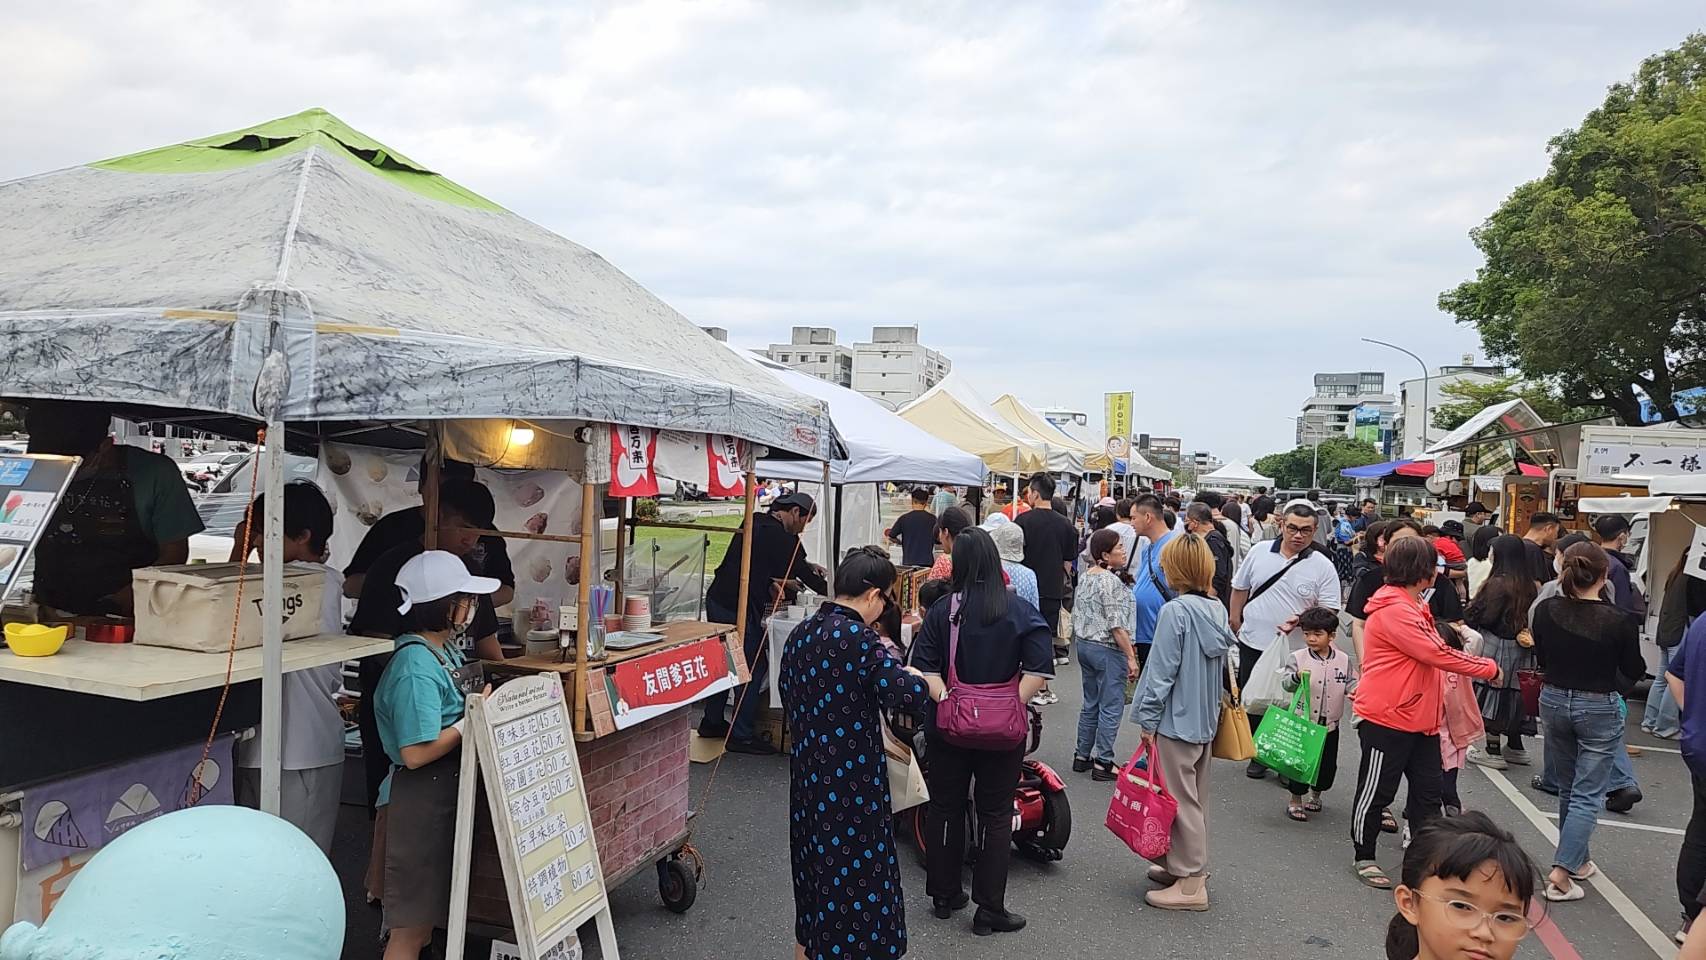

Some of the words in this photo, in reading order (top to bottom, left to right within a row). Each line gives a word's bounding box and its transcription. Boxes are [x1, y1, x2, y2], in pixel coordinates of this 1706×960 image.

[642, 655, 710, 697] 友間爹豆花
[1334, 667, 1347, 683] LA
